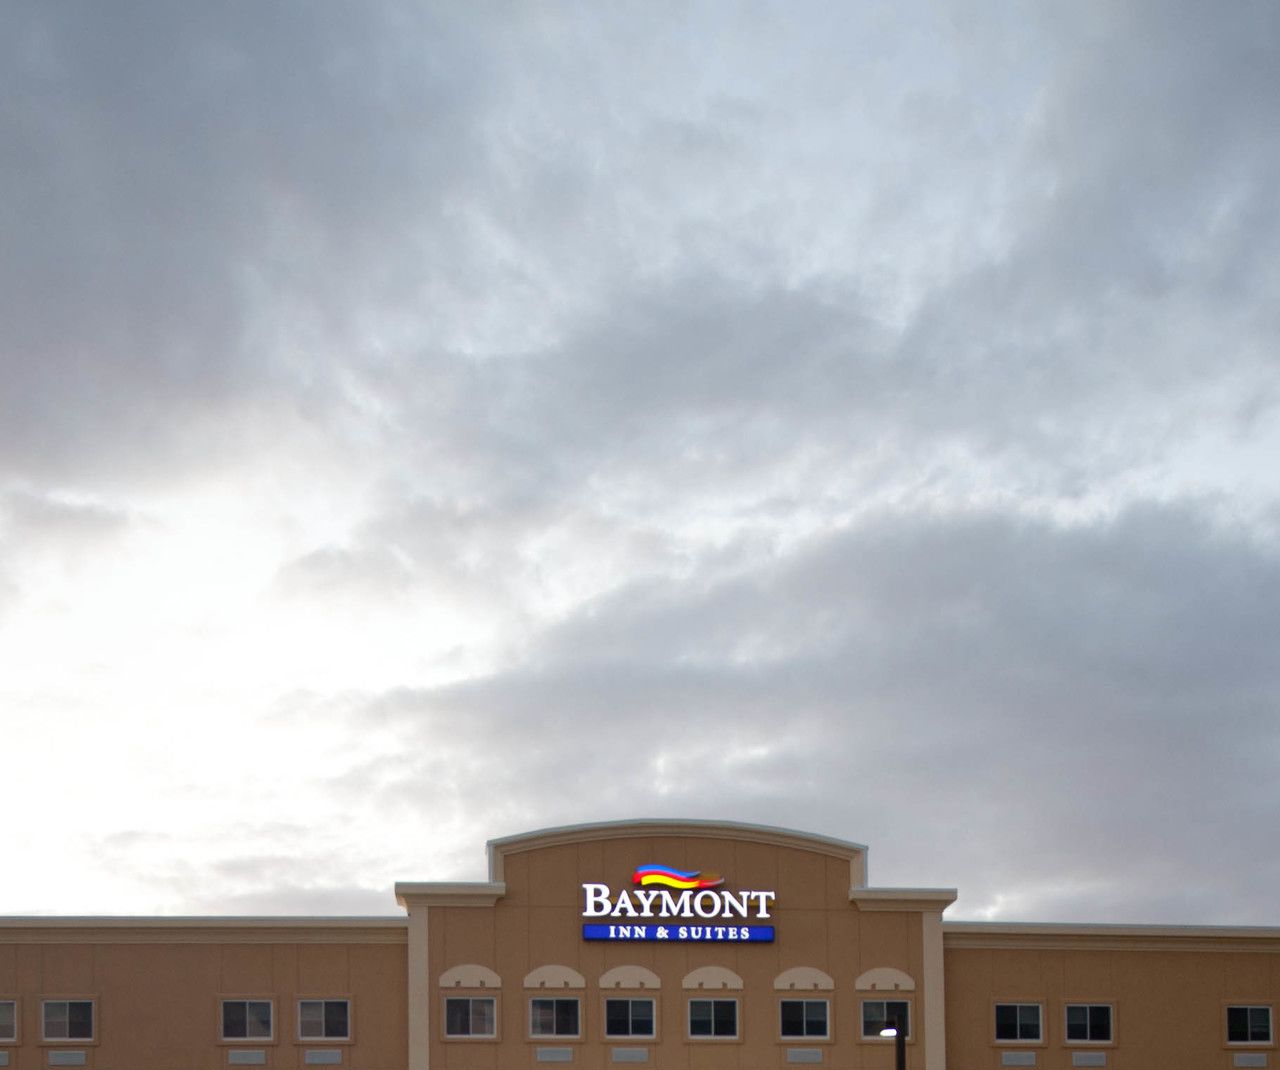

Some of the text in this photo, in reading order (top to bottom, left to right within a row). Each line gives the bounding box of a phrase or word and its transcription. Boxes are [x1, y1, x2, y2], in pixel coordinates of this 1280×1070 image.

[582, 883, 776, 918] BAYMONT
[608, 926, 751, 939] INN & SUITES
